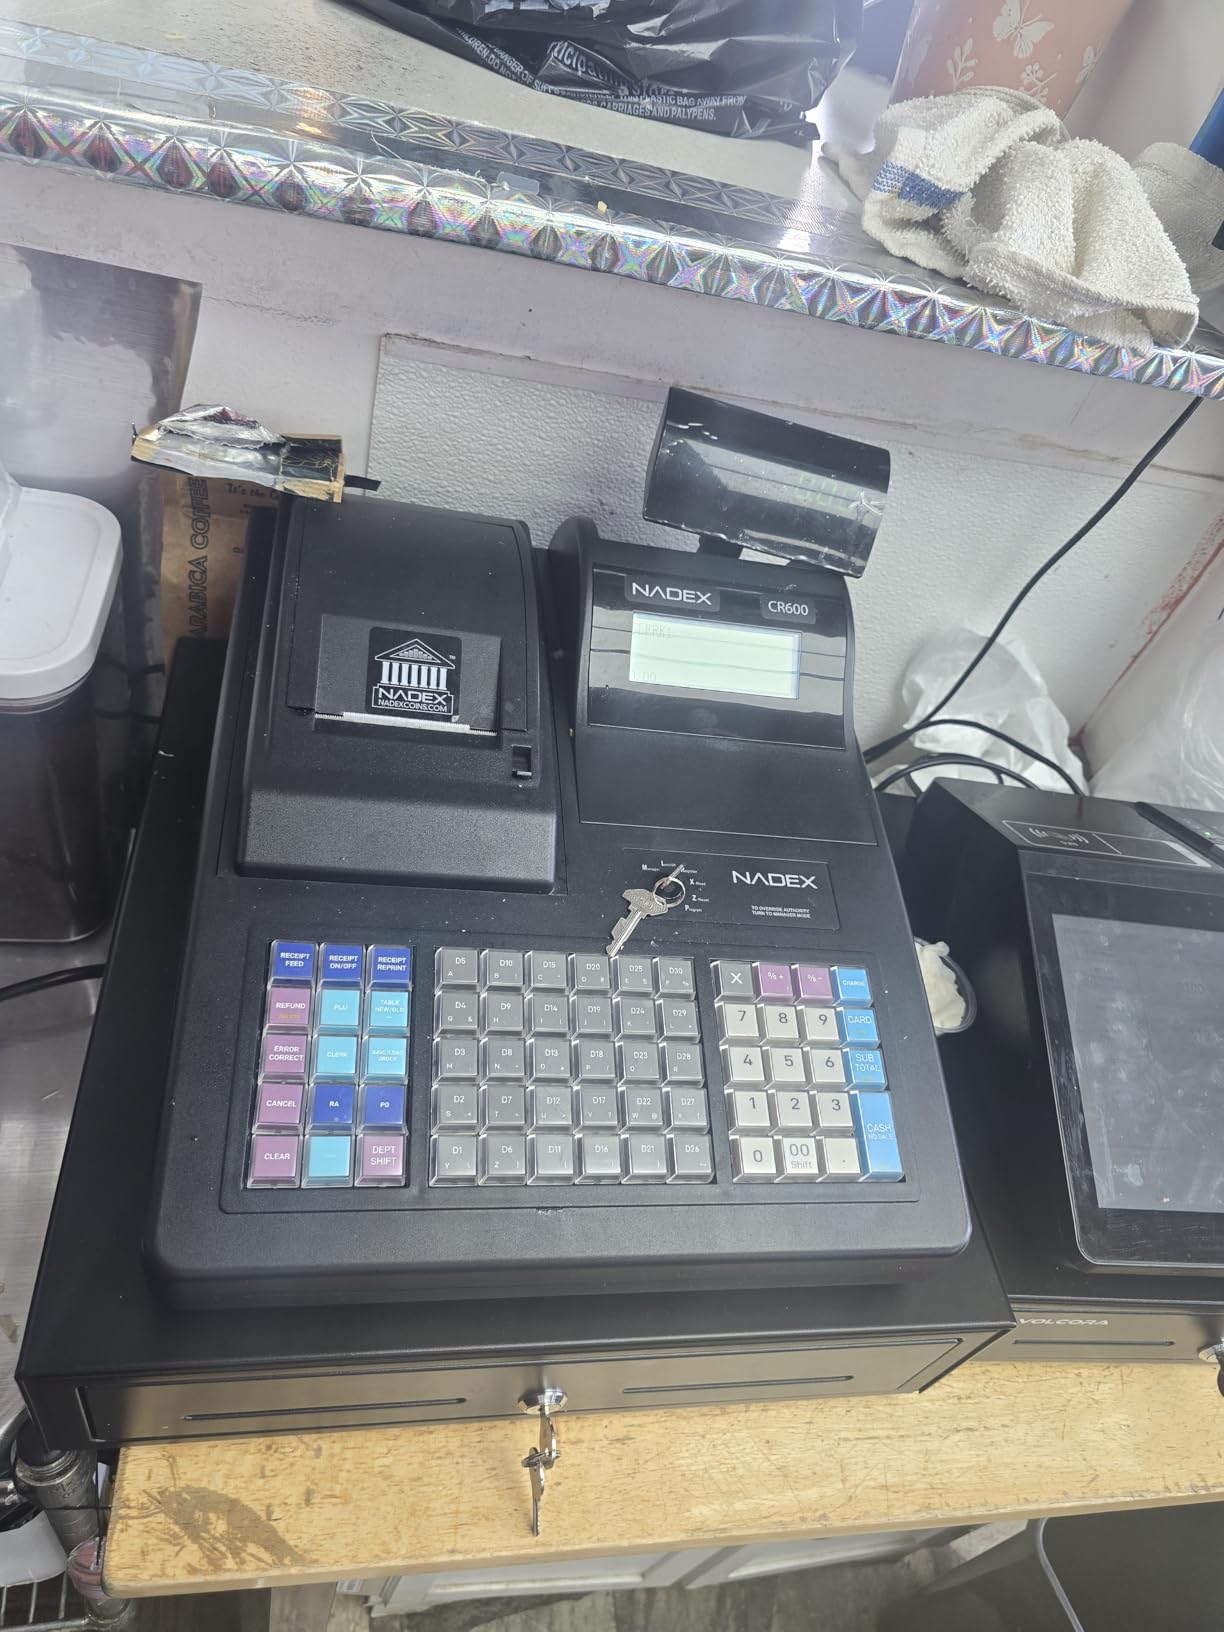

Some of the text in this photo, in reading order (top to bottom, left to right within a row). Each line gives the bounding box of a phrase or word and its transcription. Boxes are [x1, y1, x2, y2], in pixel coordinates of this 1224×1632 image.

[677, 96, 695, 106] BAG
[697, 96, 720, 106] AWAY
[601, 101, 652, 117] CARRIAGES
[652, 105, 670, 118] AND
[633, 583, 712, 605] NADEX
[768, 600, 808, 616] CR600
[378, 688, 447, 705] NADEX
[378, 699, 447, 712] NADEXCOINS.COM
[732, 870, 818, 889] NADEX
[738, 1010, 747, 1022] 7
[779, 1012, 788, 1024] 8
[819, 1014, 828, 1025] 9
[743, 1055, 753, 1065] 4
[784, 1055, 793, 1067] 5
[825, 1056, 834, 1068] 6
[856, 1054, 874, 1062] SUB
[750, 1098, 756, 1109] 1
[791, 1098, 800, 1109] 2
[832, 1099, 841, 1110] 3
[867, 1124, 891, 1132] CASH
[372, 1145, 396, 1154] DEPT
[790, 1144, 810, 1156] 00
[370, 1157, 396, 1165] SHIFT
[753, 1150, 763, 1162] 0
[791, 1160, 812, 1169] Shift
[1018, 1318, 1109, 1326] VOLCORA
